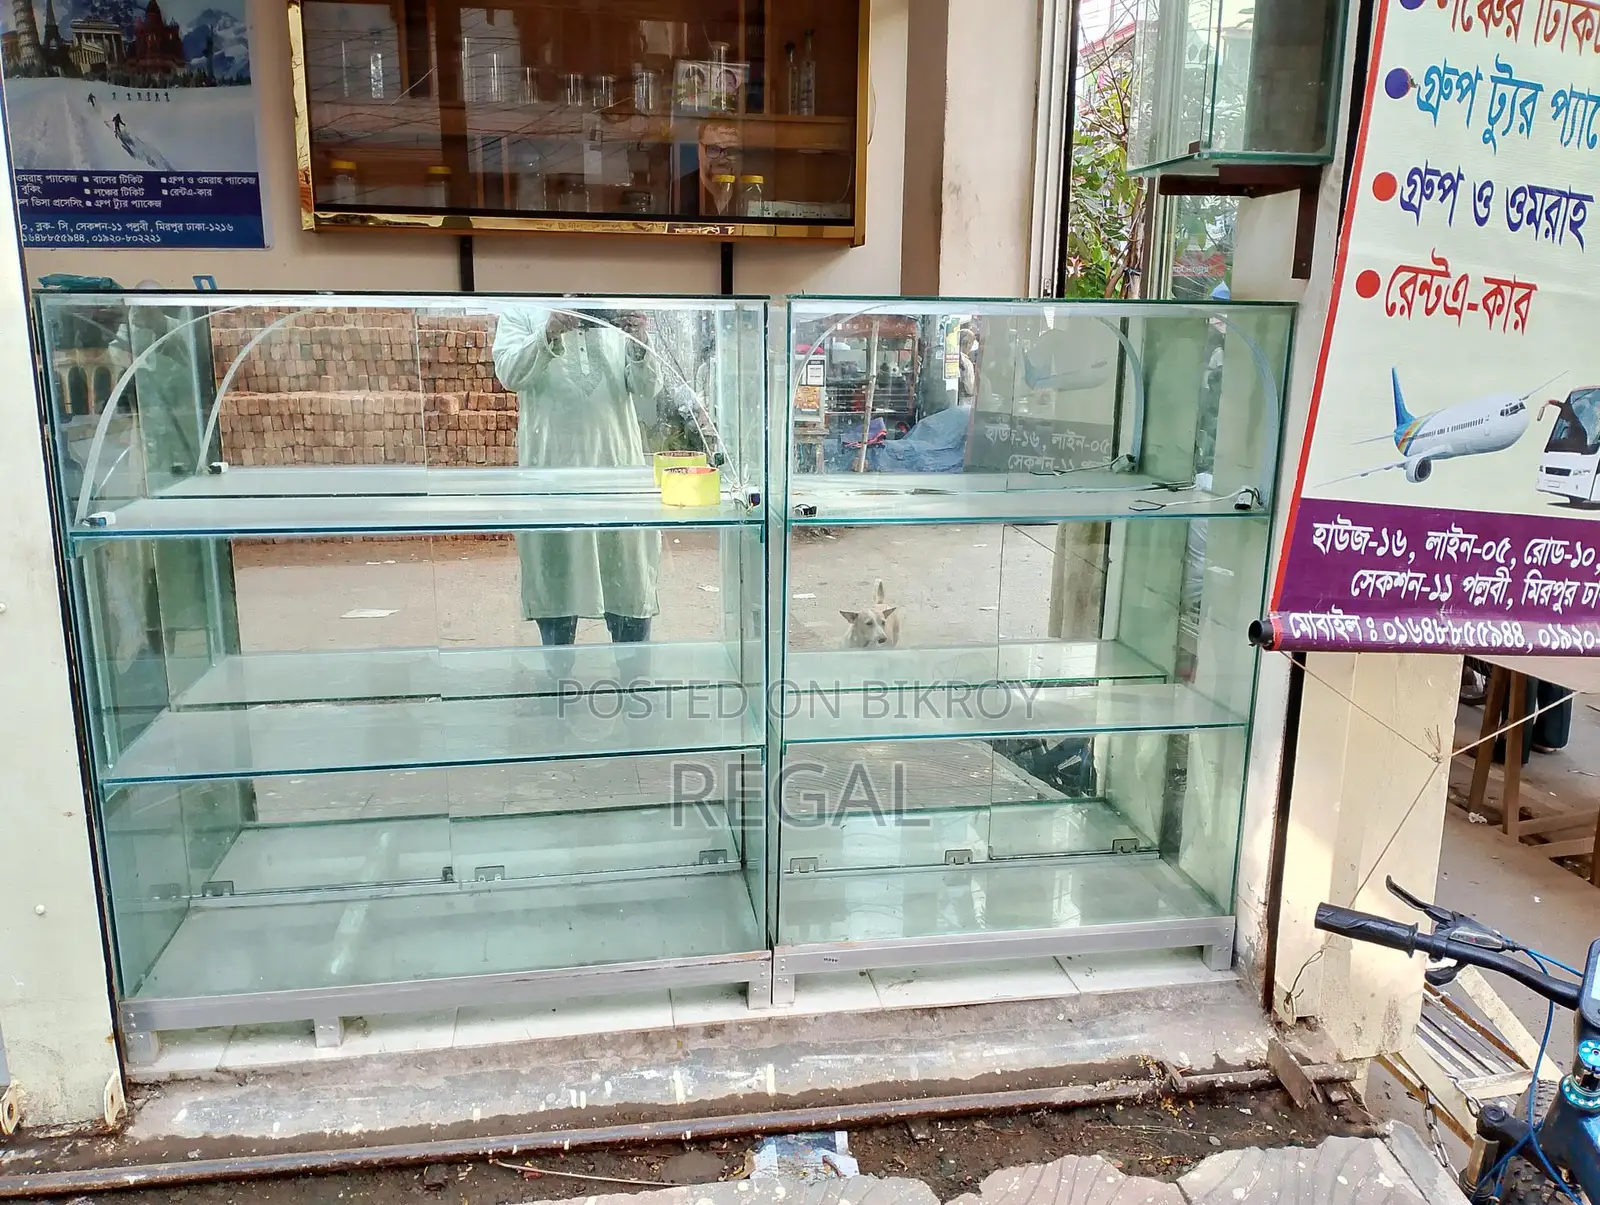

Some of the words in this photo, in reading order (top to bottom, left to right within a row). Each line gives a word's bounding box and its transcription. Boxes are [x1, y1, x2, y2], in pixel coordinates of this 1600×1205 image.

[1417, 58, 1483, 129] গ্রুপ
[1482, 54, 1544, 155] ট্যুর
[92, 175, 117, 184] বাসের
[119, 174, 144, 184] টিকিট
[120, 186, 145, 197] টিকিট
[155, 220, 183, 233] মিরপুর
[186, 222, 234, 232] ঢাকা-১২১৬
[1400, 159, 1464, 227] গ্রুপ
[1473, 179, 1494, 228] ও
[1506, 184, 1594, 252] ওমরাহ
[1385, 247, 1539, 335] রেন্টএ-কার
[1312, 514, 1416, 564] হাউজ-১৬,
[1425, 523, 1517, 570] লাইন-০৫,
[1351, 569, 1453, 601] সেকশন-১১
[1521, 568, 1581, 615] মিরপুর
[1289, 604, 1363, 643] মোবাইল
